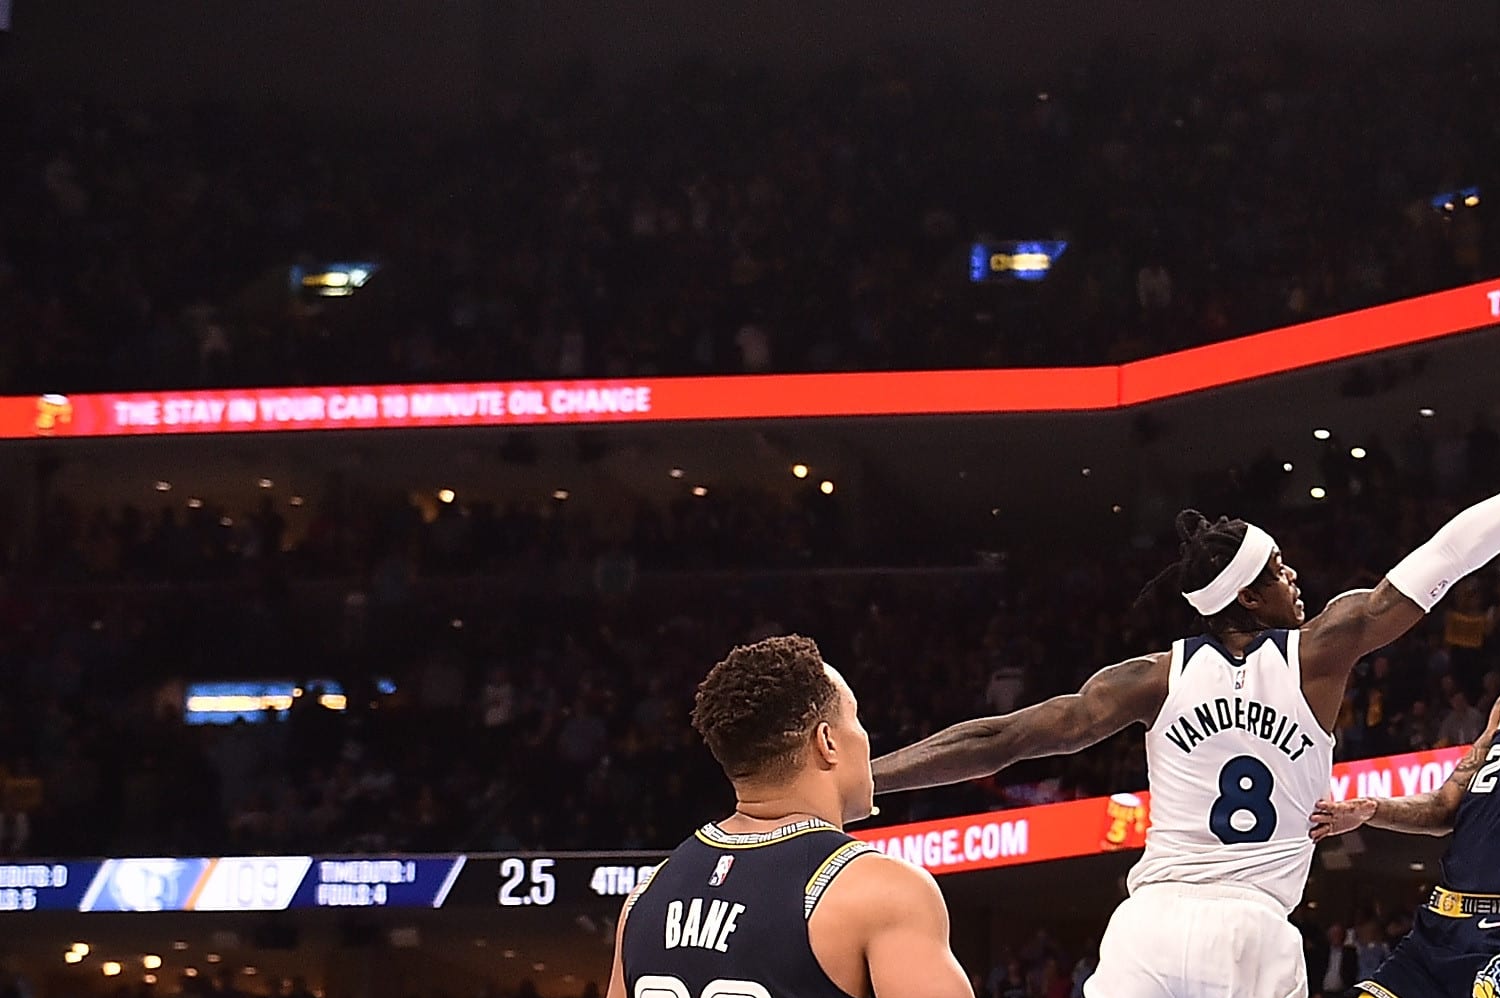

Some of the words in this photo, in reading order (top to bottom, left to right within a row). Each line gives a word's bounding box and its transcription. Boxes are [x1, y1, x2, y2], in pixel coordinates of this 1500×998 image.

[114, 400, 160, 426] THE
[162, 398, 225, 425] STAY
[228, 398, 256, 423] IN
[258, 395, 325, 422] YOUR
[328, 395, 378, 419] CAR
[381, 394, 407, 418] 10
[410, 390, 506, 417] MINUTE
[508, 389, 547, 415] OIL
[550, 386, 651, 414] CHANGE
[1165, 697, 1314, 762] VANDERBILT
[1209, 755, 1277, 845] 8
[1358, 769, 1391, 798] IN
[499, 858, 555, 905] 2.5
[590, 866, 636, 896] 4TH
[665, 898, 746, 953] BANE
